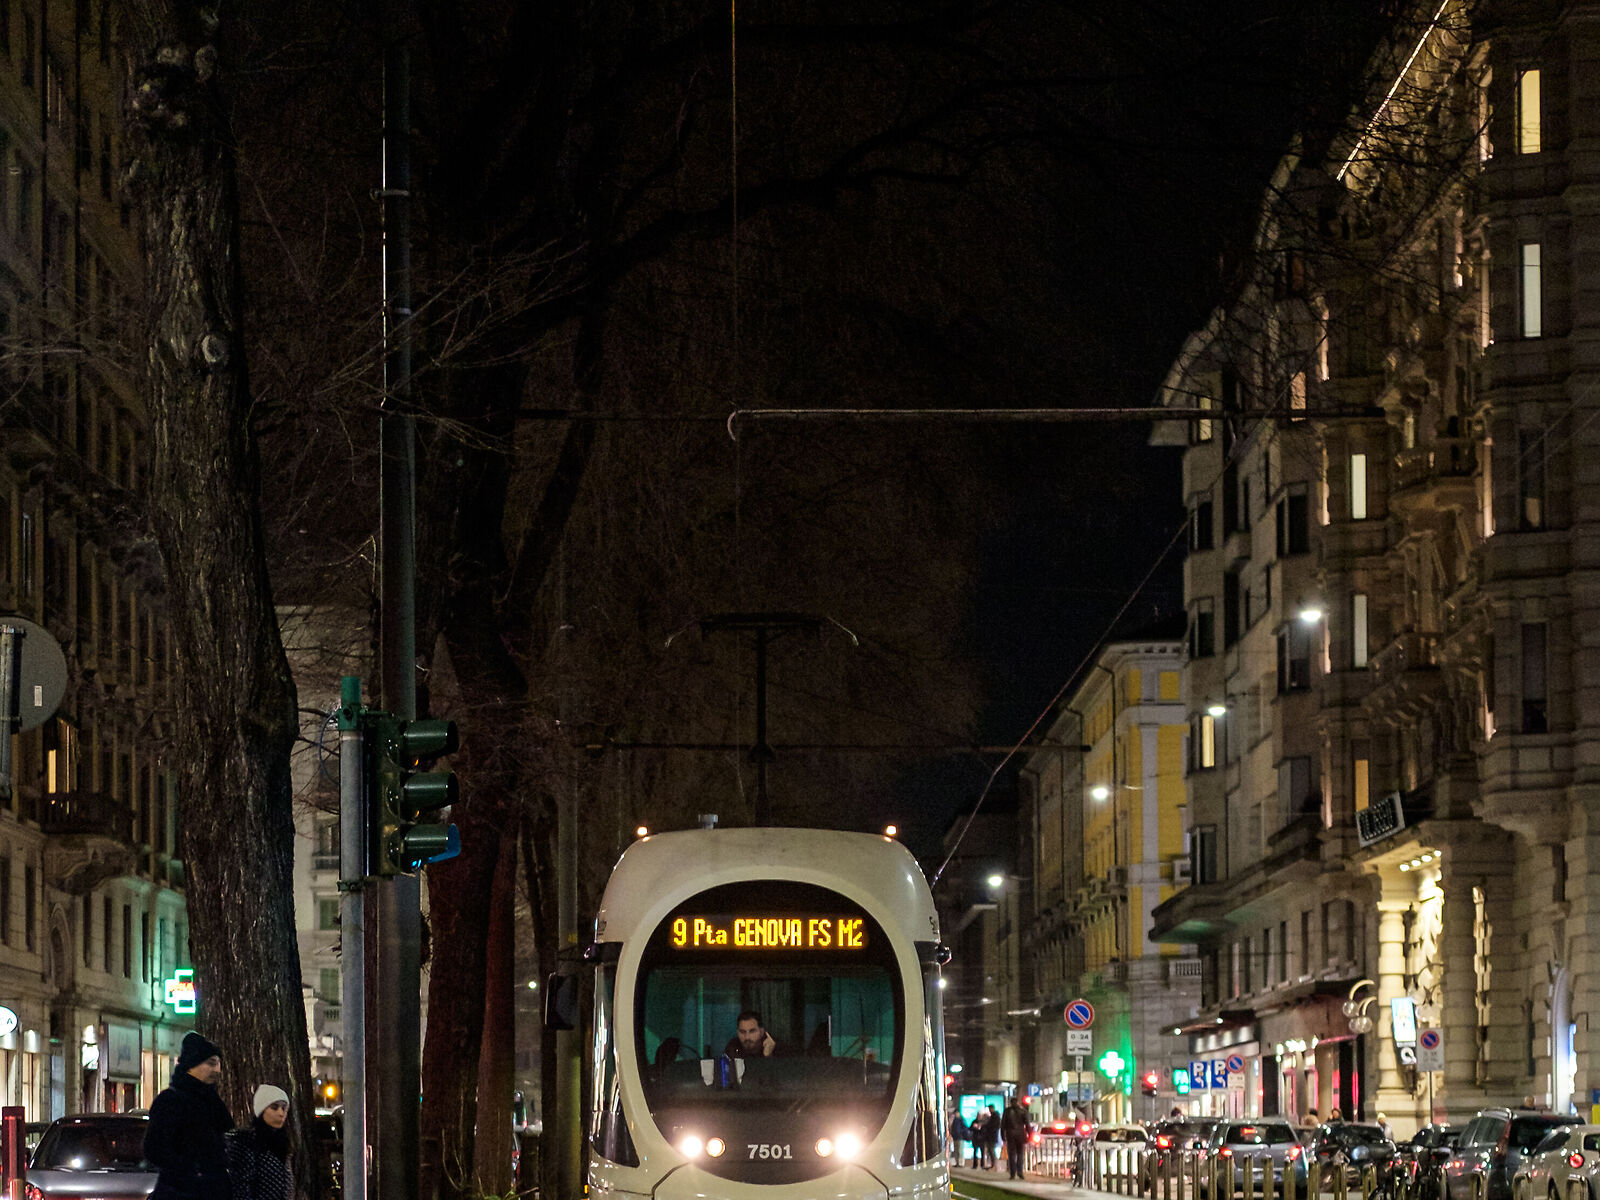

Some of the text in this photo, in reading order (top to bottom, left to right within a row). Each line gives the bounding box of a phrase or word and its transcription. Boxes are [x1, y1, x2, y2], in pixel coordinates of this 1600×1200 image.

[673, 918, 863, 947] 9 Pta GENOVA FS M2
[1193, 1062, 1204, 1076] P
[1214, 1061, 1226, 1076] P
[1031, 1086, 1039, 1096] P
[747, 1144, 793, 1159] 7501
